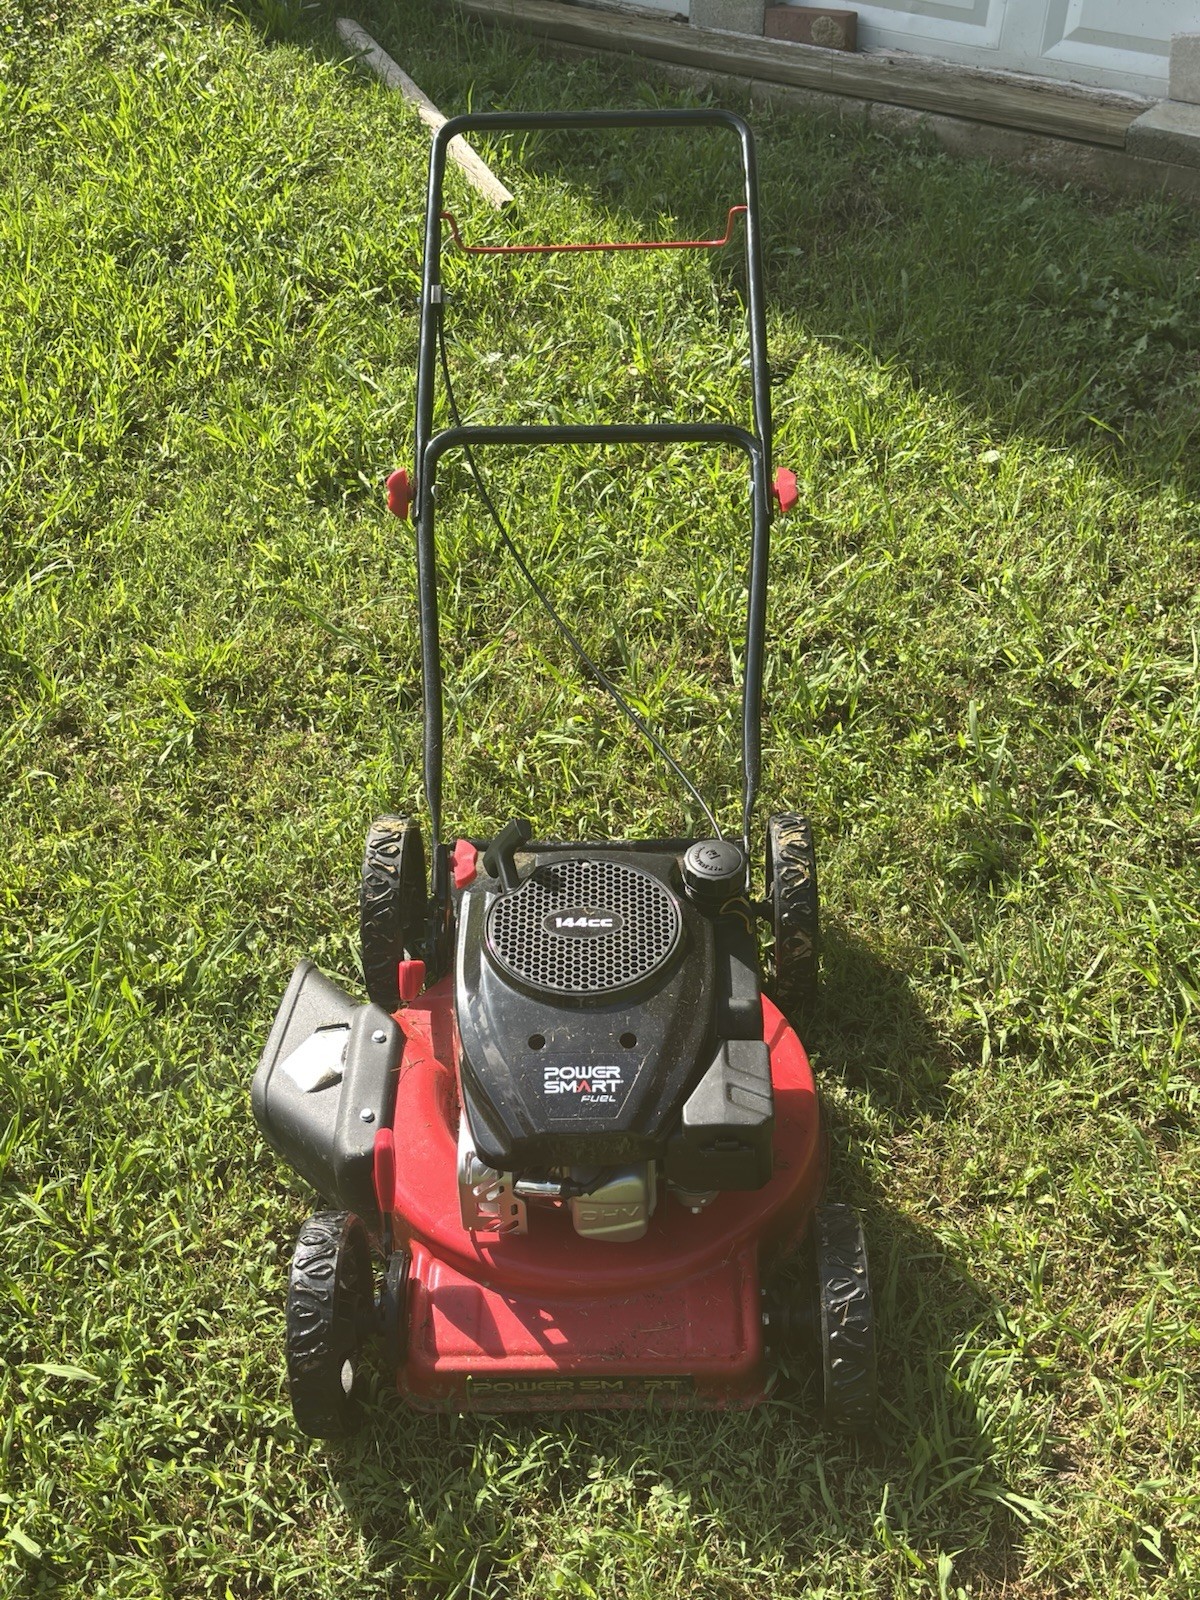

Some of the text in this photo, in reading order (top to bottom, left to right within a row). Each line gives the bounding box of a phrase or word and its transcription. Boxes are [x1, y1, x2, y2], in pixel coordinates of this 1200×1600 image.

[555, 917, 613, 928] 144cc
[544, 1066, 621, 1080] POWER
[543, 1080, 624, 1094] SMART
[580, 1095, 617, 1103] FUEL
[581, 1206, 640, 1221] OHV
[473, 1380, 682, 1393] POWER SMRT
